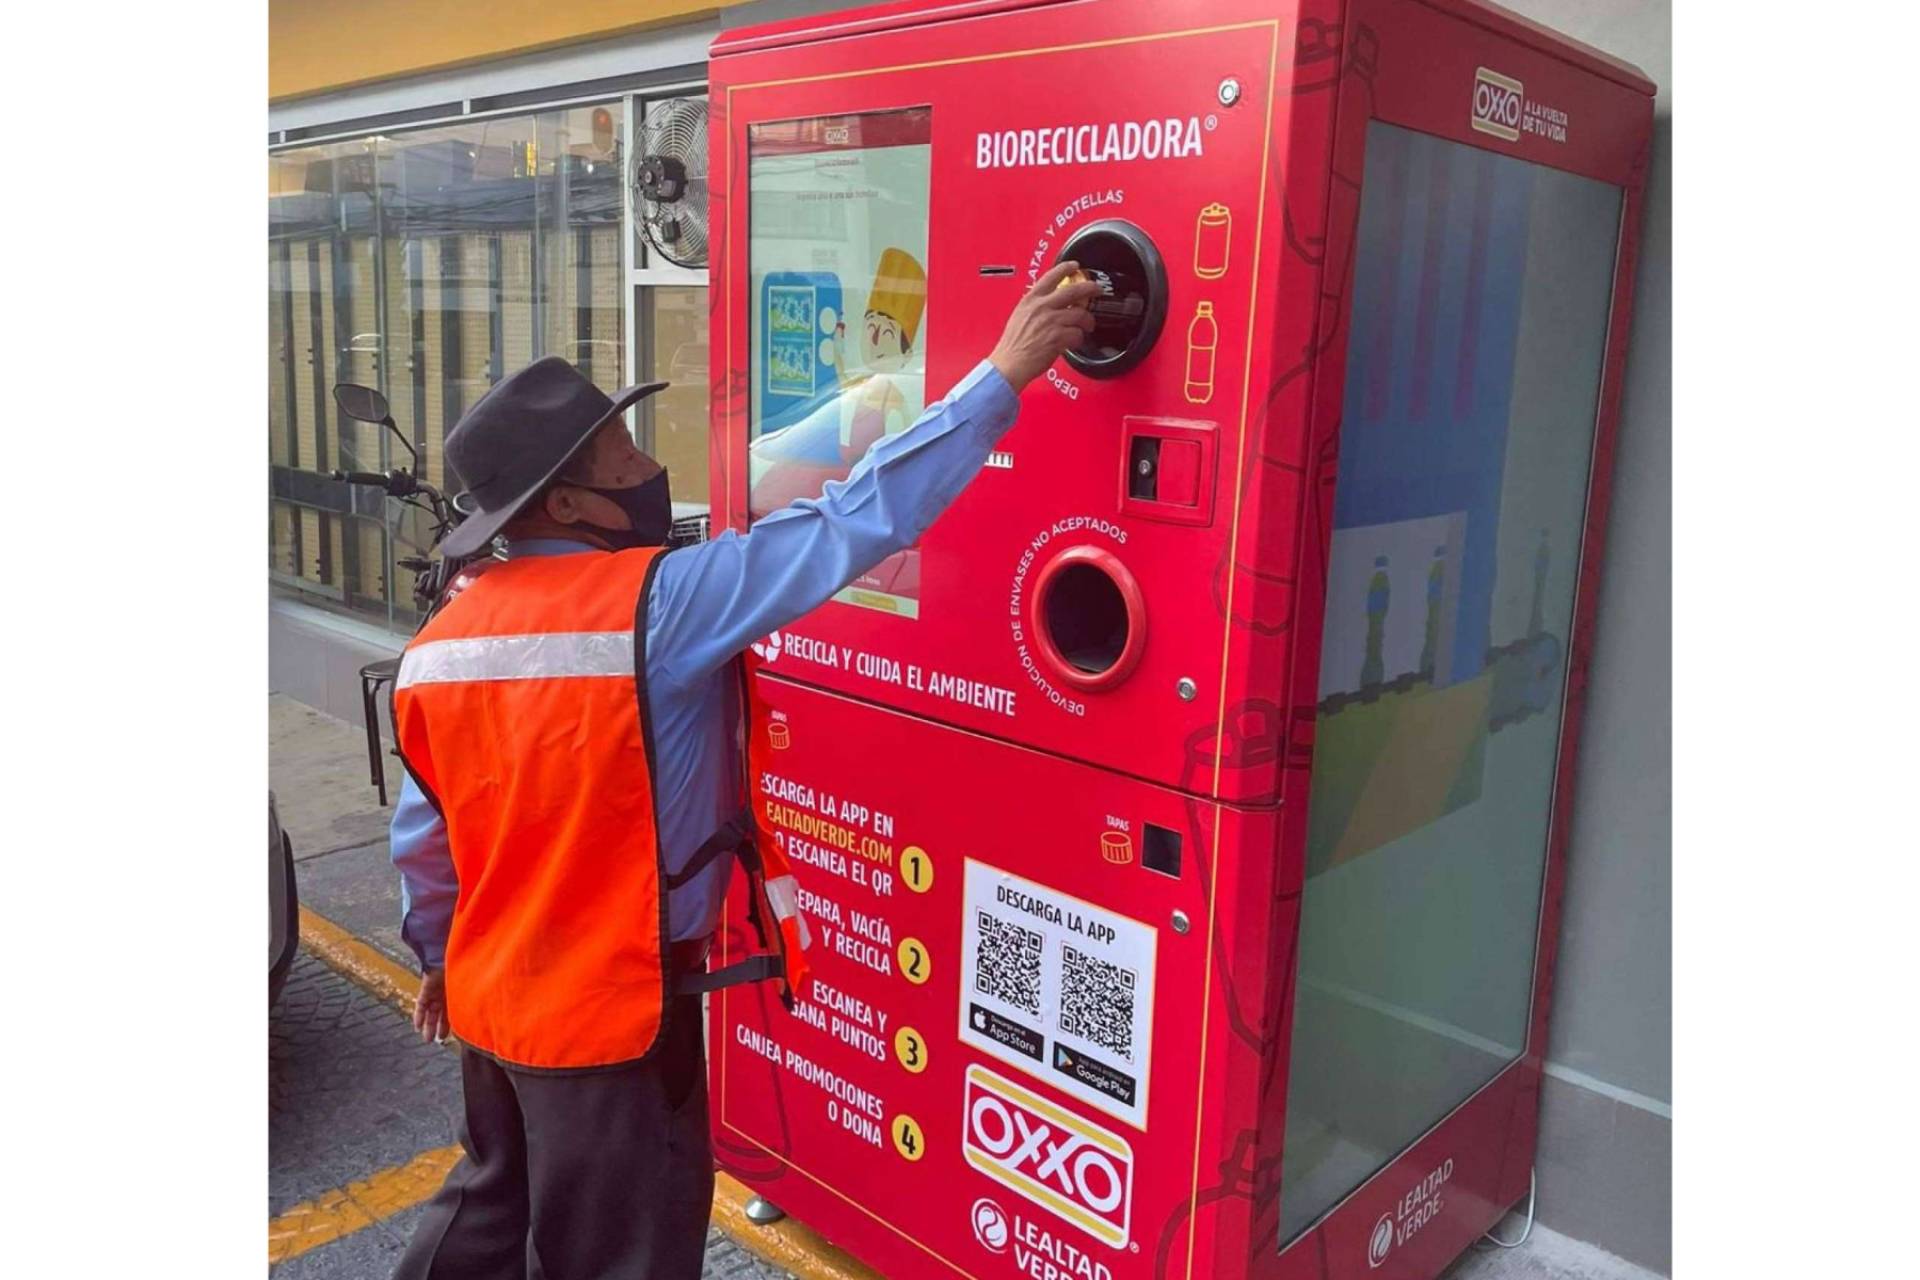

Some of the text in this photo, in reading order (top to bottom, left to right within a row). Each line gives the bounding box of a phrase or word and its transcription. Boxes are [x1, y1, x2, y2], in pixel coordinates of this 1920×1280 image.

[1476, 84, 1520, 126] OXXO
[1055, 189, 1125, 228] BOTELLAS
[1010, 516, 1128, 717] DEVOLUCIÓN DE ENVASES NO ACEPTADOS
[784, 632, 1016, 717] RECICLA Y CUIDA EL AMBIENTE
[819, 792, 836, 818] LA
[840, 800, 870, 828] APP
[873, 812, 894, 838] EN
[1105, 814, 1130, 832] TAPAS
[788, 836, 848, 879] ESCANEA
[851, 860, 868, 886] EL
[871, 868, 893, 897] QR
[910, 856, 920, 886] 1
[795, 888, 893, 948] EPARA, VACÍA
[996, 885, 1116, 946] DESCARGA LA APP
[821, 925, 892, 976] Y RECICLA
[908, 946, 922, 977] 2
[812, 979, 888, 1034] ESCANEA Y
[831, 1016, 887, 1062] PUNTOS
[905, 1035, 919, 1067] 3
[989, 1023, 1010, 1043] App
[1010, 1033, 1036, 1055] Store
[736, 1023, 884, 1121] CANJEA PROMOCIONES
[1076, 1064, 1111, 1090] Google
[1110, 1079, 1131, 1101] Play
[827, 1099, 883, 1149] O DONA
[901, 1123, 916, 1155] 4
[971, 1095, 1123, 1214] OXXO
[1397, 1158, 1454, 1222] LEALTAD
[1014, 1215, 1113, 1280] LEALTAD
